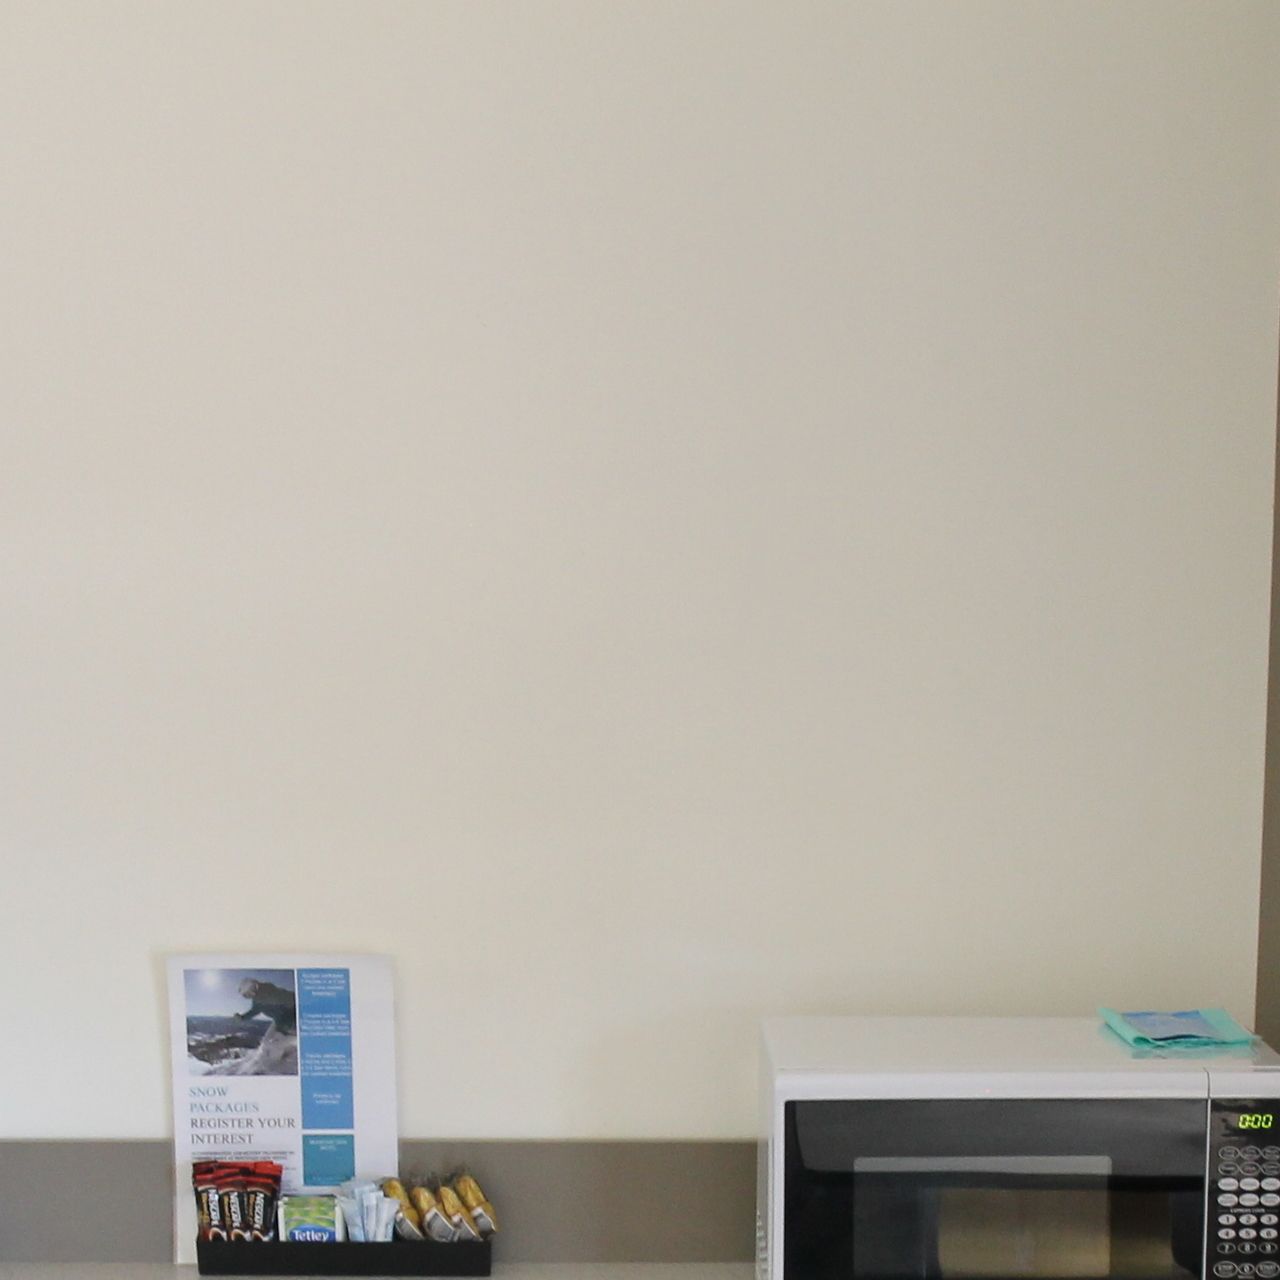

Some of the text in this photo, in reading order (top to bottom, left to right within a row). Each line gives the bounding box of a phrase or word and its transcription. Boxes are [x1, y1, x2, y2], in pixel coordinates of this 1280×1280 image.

[189, 1086, 227, 1097] SNOW
[190, 1102, 260, 1113] PACKAGES
[190, 1117, 296, 1129] REGISTER YOUR
[1238, 1113, 1273, 1129] 0:00
[191, 1133, 254, 1145] INTEREST
[293, 1229, 329, 1241] Tetley
